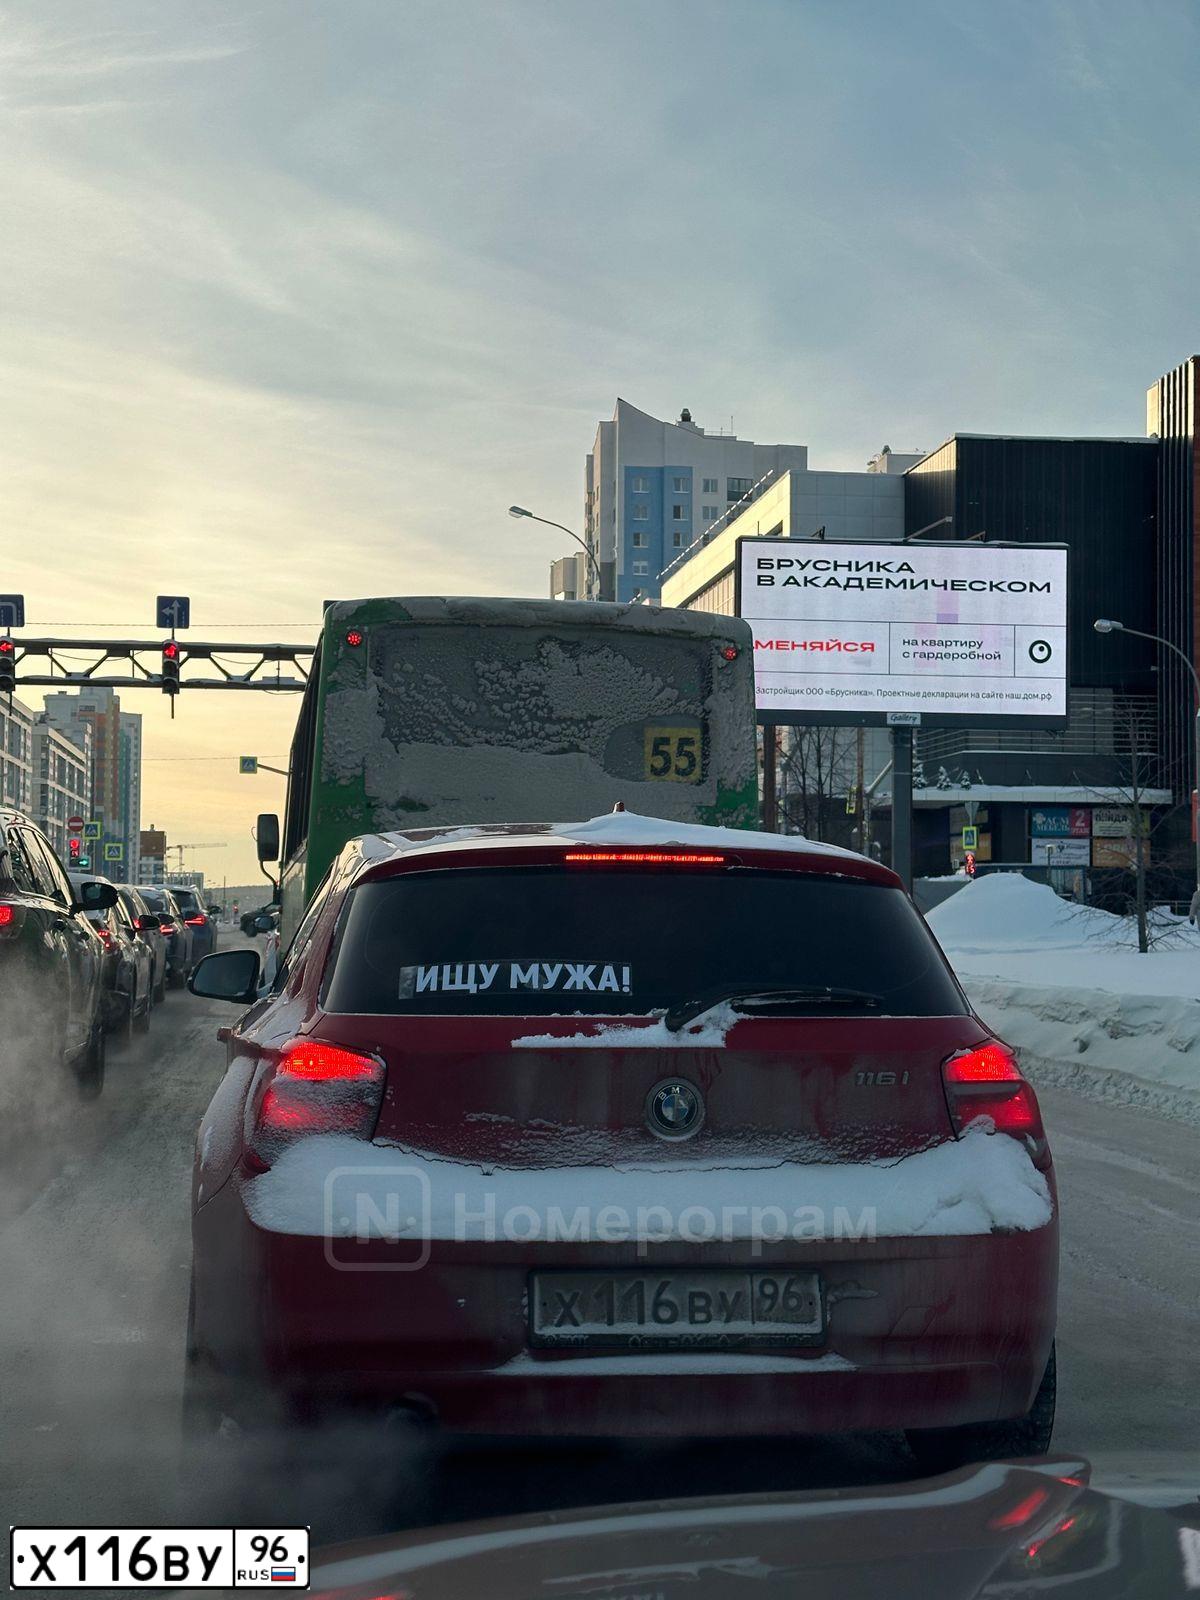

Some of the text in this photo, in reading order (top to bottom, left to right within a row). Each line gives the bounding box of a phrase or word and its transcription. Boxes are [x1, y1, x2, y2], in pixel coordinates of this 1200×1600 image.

[757, 558, 915, 574] БРУСНИКА
[756, 574, 1051, 593] В АКАДЕМИЧЕСКОМ
[752, 639, 875, 653] МЕНЯЙСЯ
[921, 639, 983, 650] квартиру
[902, 650, 1001, 661] с гардеробной
[755, 686, 804, 696] Застройщик
[805, 687, 824, 696] ООО
[876, 689, 921, 698] Проектные
[922, 690, 969, 699] декларации
[981, 691, 1004, 700] сайте
[650, 736, 696, 777] 55
[1075, 810, 1086, 827] 2
[415, 963, 631, 994] ИЩУ МУЖА!
[757, 1277, 804, 1313] 96
